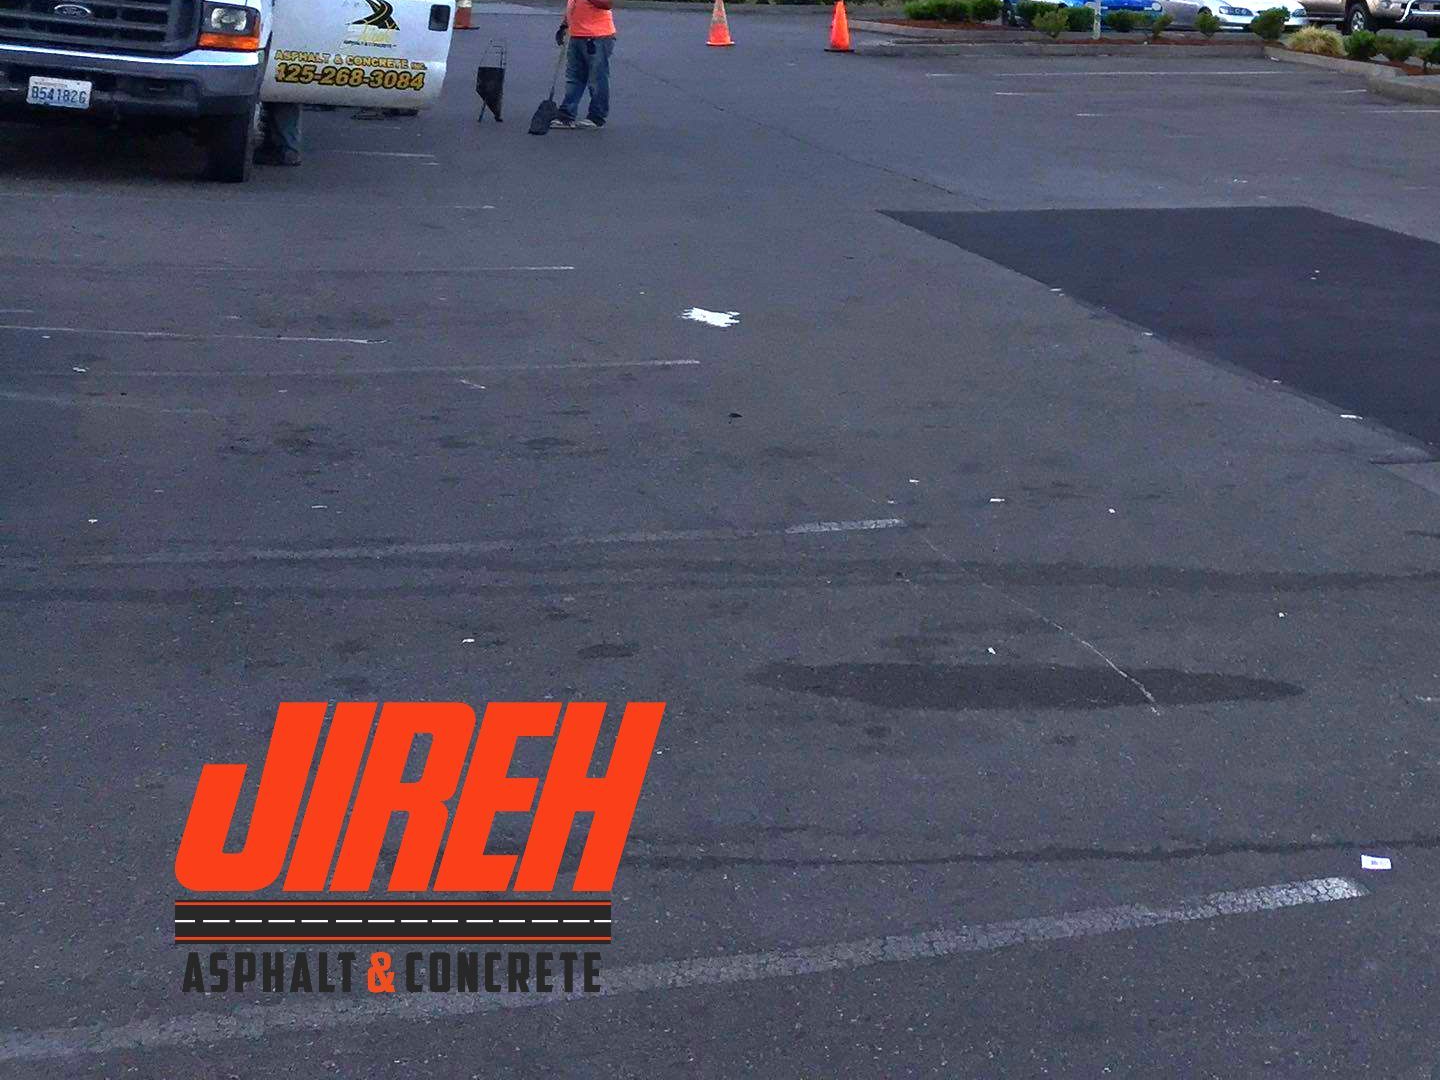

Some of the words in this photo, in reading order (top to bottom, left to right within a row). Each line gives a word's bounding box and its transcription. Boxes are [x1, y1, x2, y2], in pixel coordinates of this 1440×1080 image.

[274, 49, 331, 64] ASPHALT
[333, 54, 343, 65] &
[345, 55, 410, 70] CONCRETE
